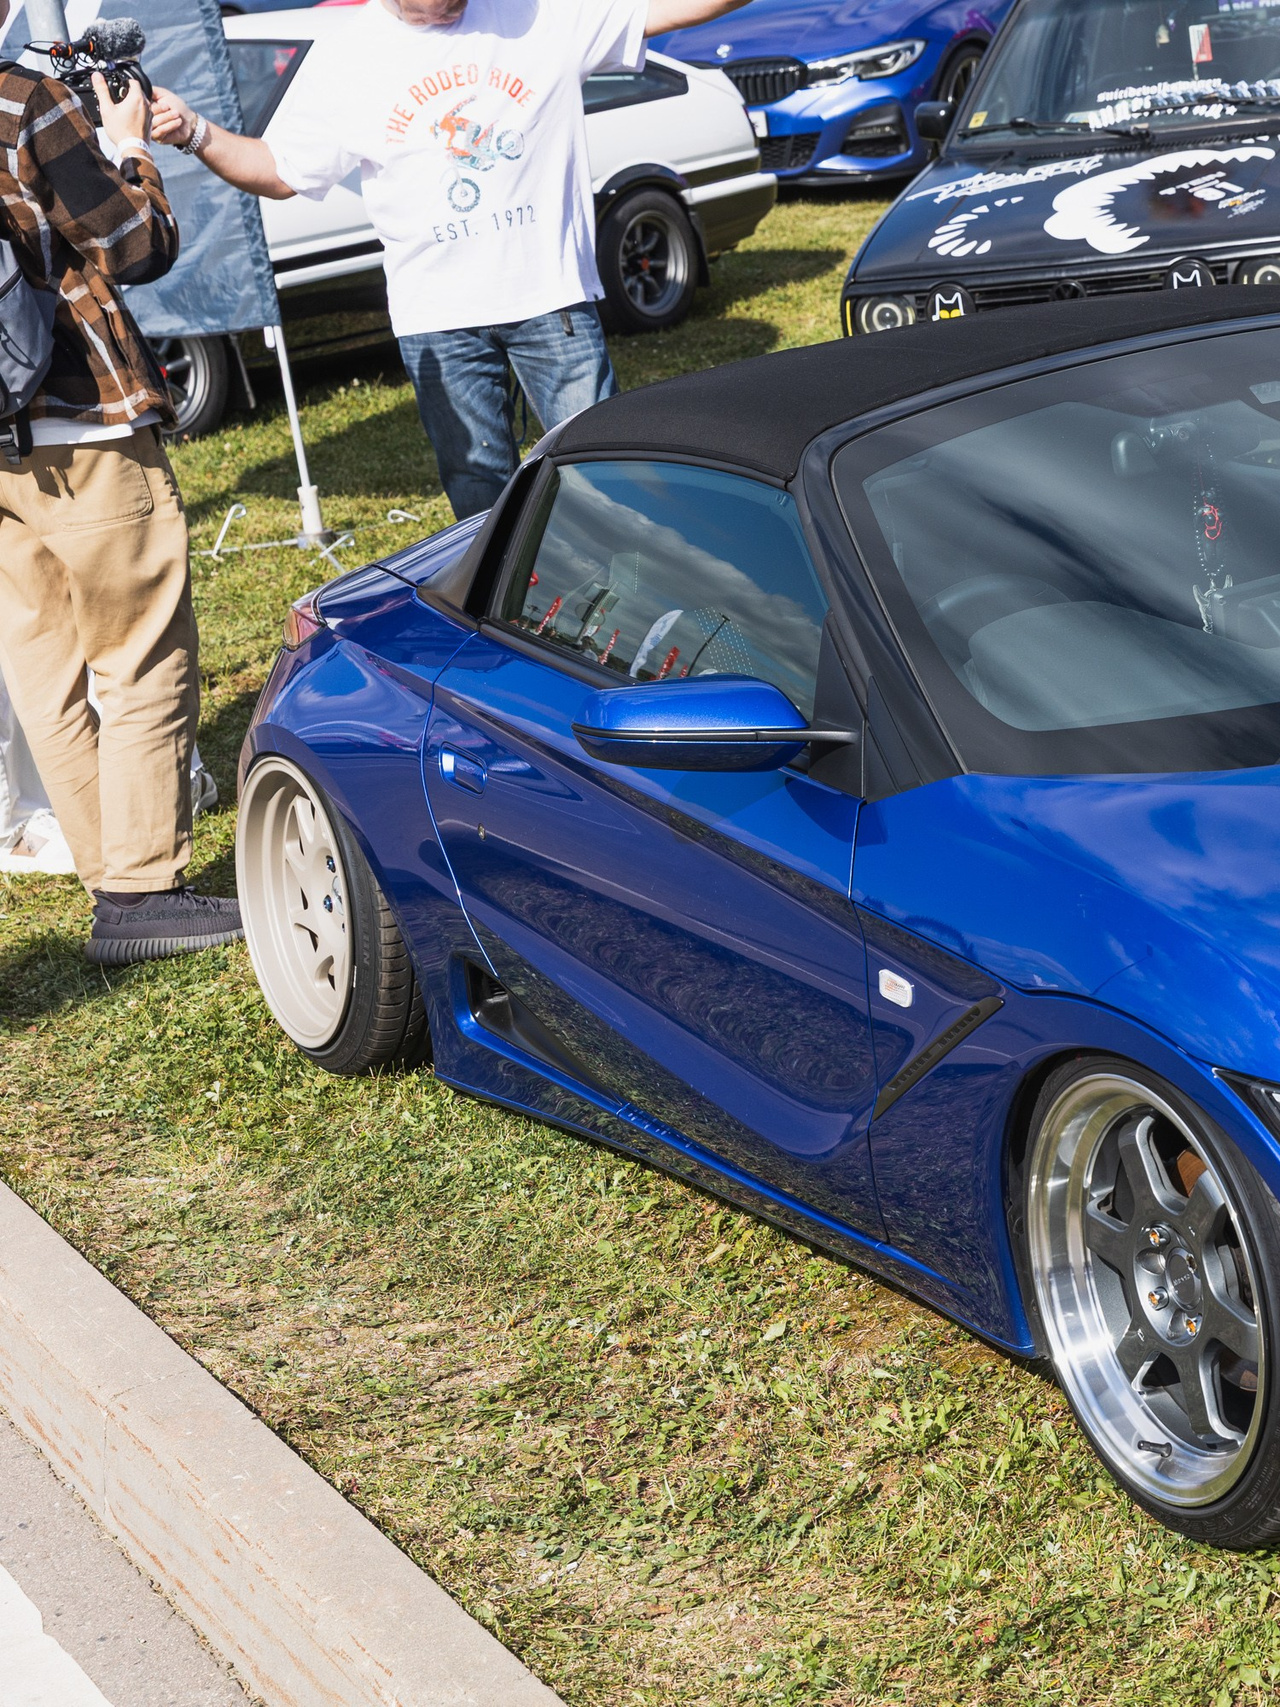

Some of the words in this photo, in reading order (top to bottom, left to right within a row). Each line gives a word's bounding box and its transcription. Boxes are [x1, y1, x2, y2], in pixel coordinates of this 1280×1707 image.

[386, 103, 415, 144] THE
[408, 63, 479, 106] RODEO
[488, 67, 537, 108] RIDE
[432, 219, 479, 244] EST.
[491, 204, 537, 231] 1972
